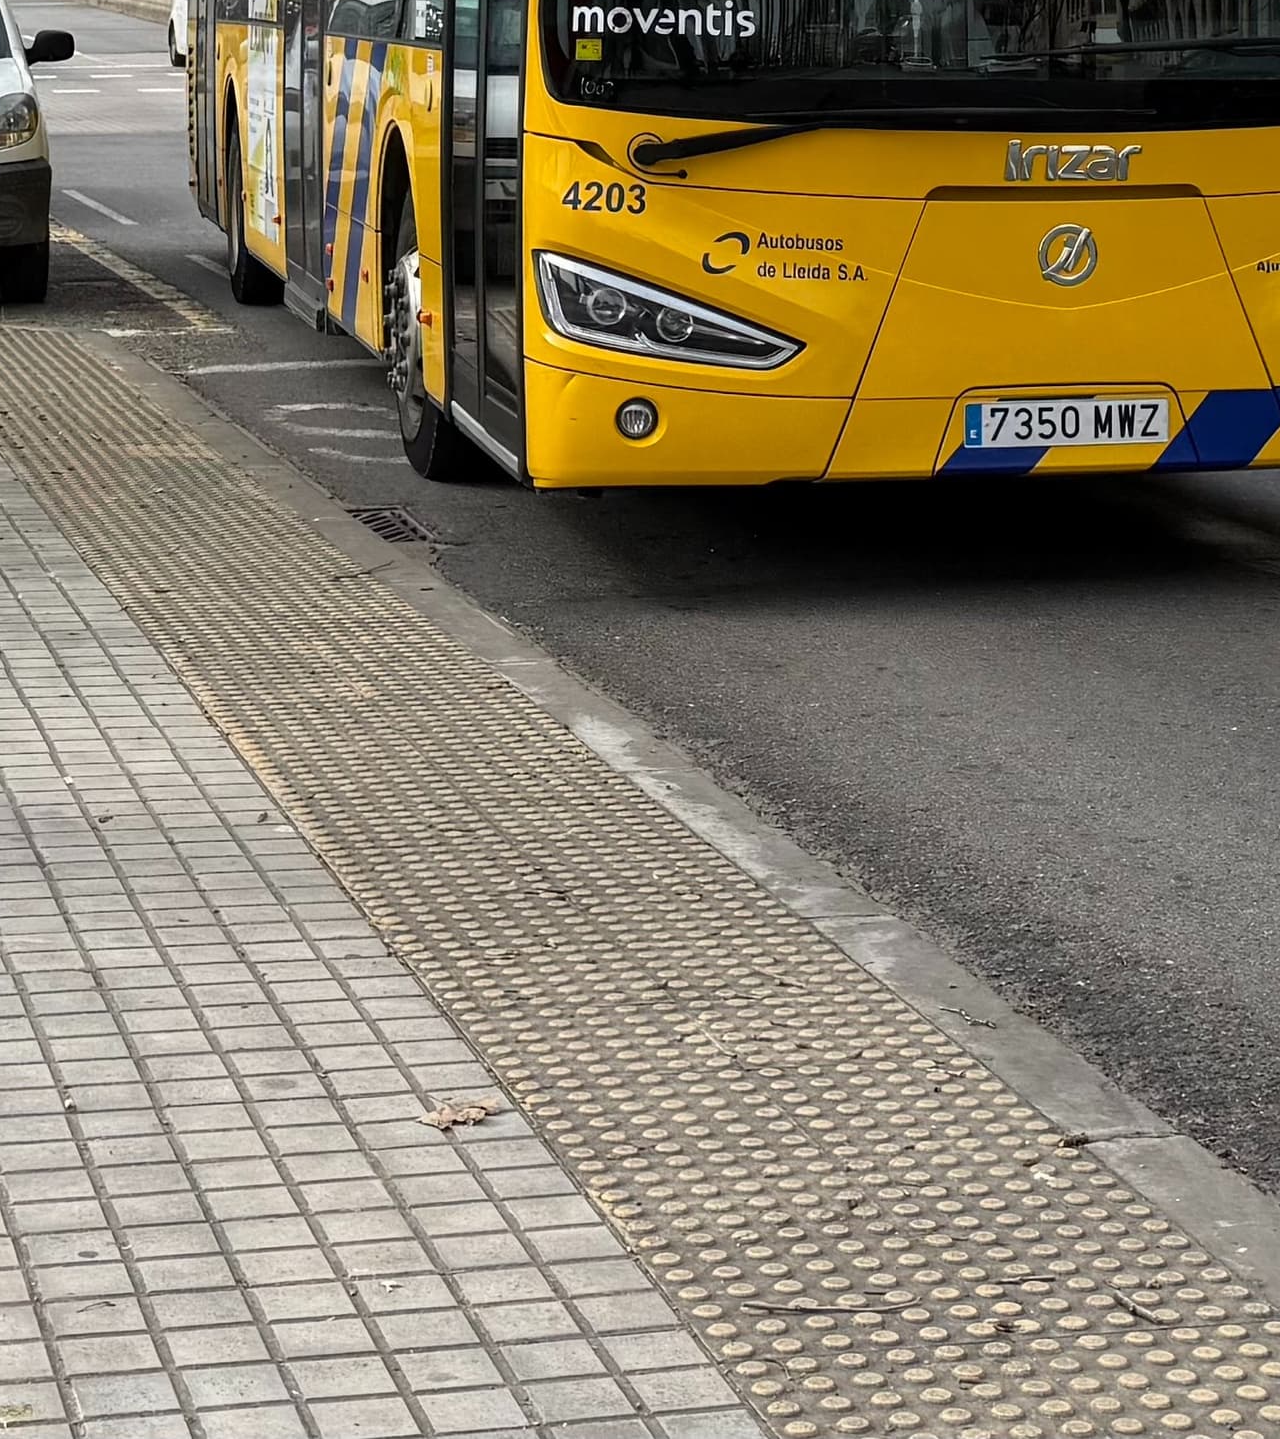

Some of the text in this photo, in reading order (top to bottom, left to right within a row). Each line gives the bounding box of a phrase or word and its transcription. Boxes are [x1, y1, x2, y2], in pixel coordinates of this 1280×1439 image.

[572, 0, 756, 37] moventis
[561, 180, 647, 215] 4203
[757, 232, 844, 252] Autobusos
[757, 261, 869, 282] de Lleida S.A.
[969, 403, 1160, 442] E 7350 MWZ
